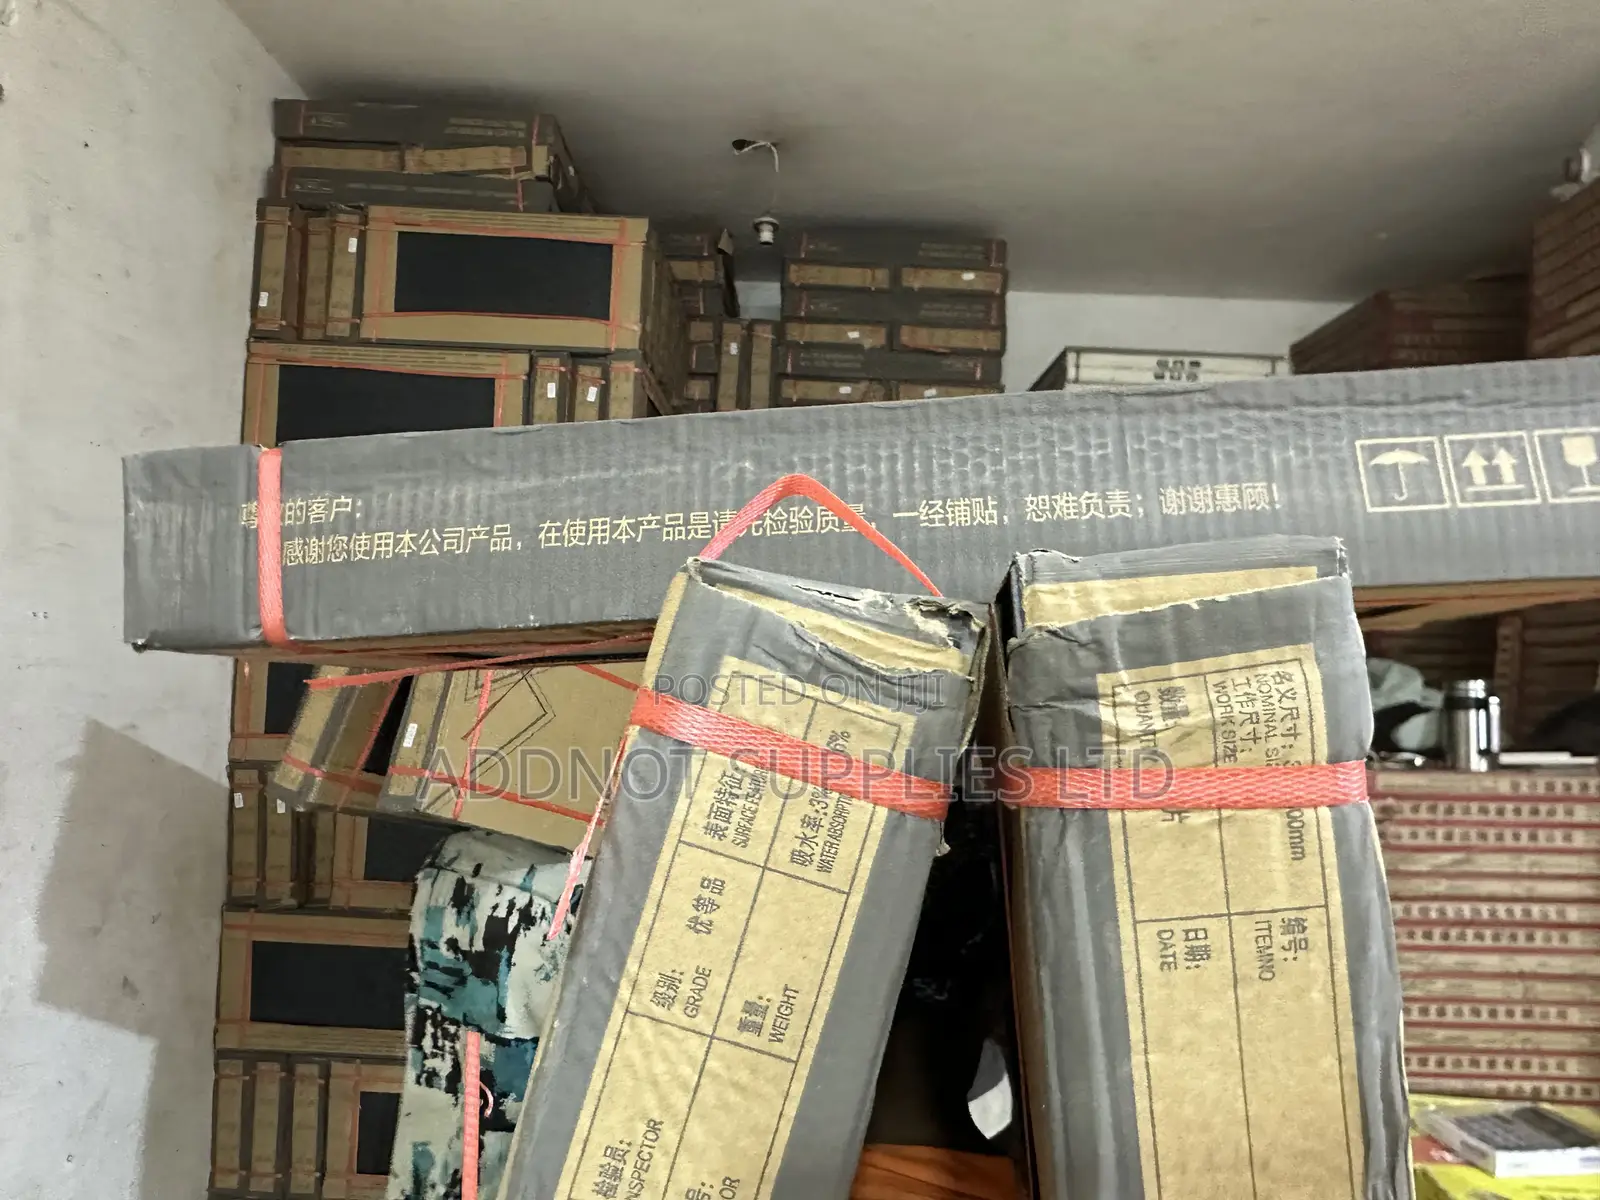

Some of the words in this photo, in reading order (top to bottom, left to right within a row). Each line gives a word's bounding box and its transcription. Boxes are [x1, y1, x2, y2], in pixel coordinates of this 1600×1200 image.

[241, 496, 363, 528] 尊的客户：
[732, 802, 759, 848] SURFACE
[817, 839, 840, 874] WATER
[1156, 929, 1178, 972] DATE
[684, 965, 712, 1018] GRADE
[768, 984, 800, 1043] WEIGHT
